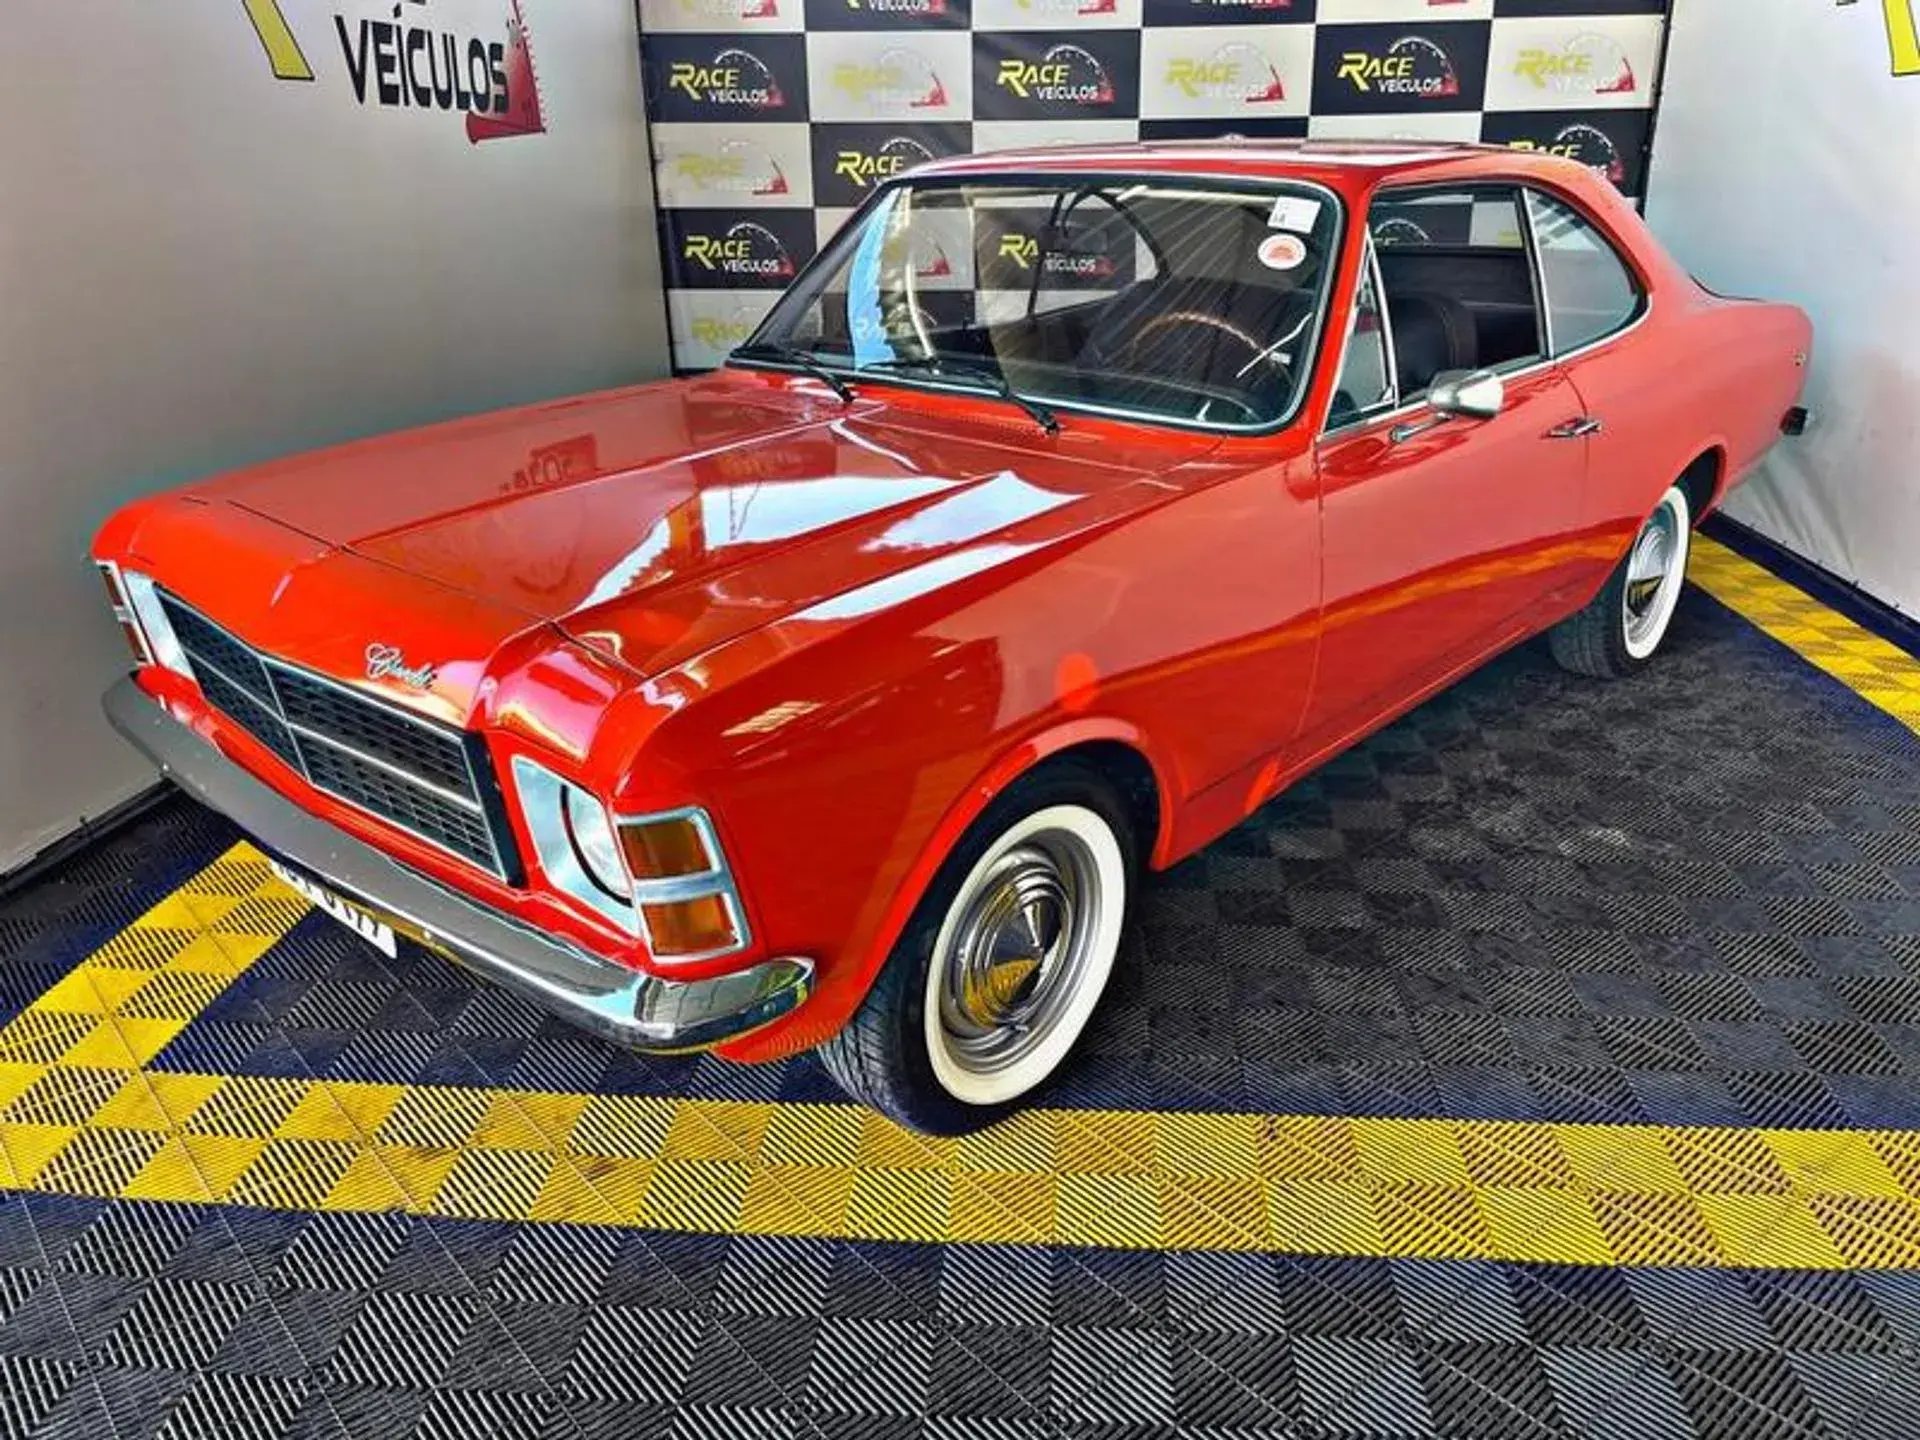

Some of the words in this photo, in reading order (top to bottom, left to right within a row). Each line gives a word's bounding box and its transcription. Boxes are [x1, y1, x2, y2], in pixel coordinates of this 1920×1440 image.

[334, 3, 510, 114] VEÍCULOS
[1337, 53, 1415, 92] RACE
[669, 63, 740, 100] RACE
[996, 60, 1071, 97] RACE
[836, 151, 904, 187] RACE
[684, 235, 751, 270] RACE
